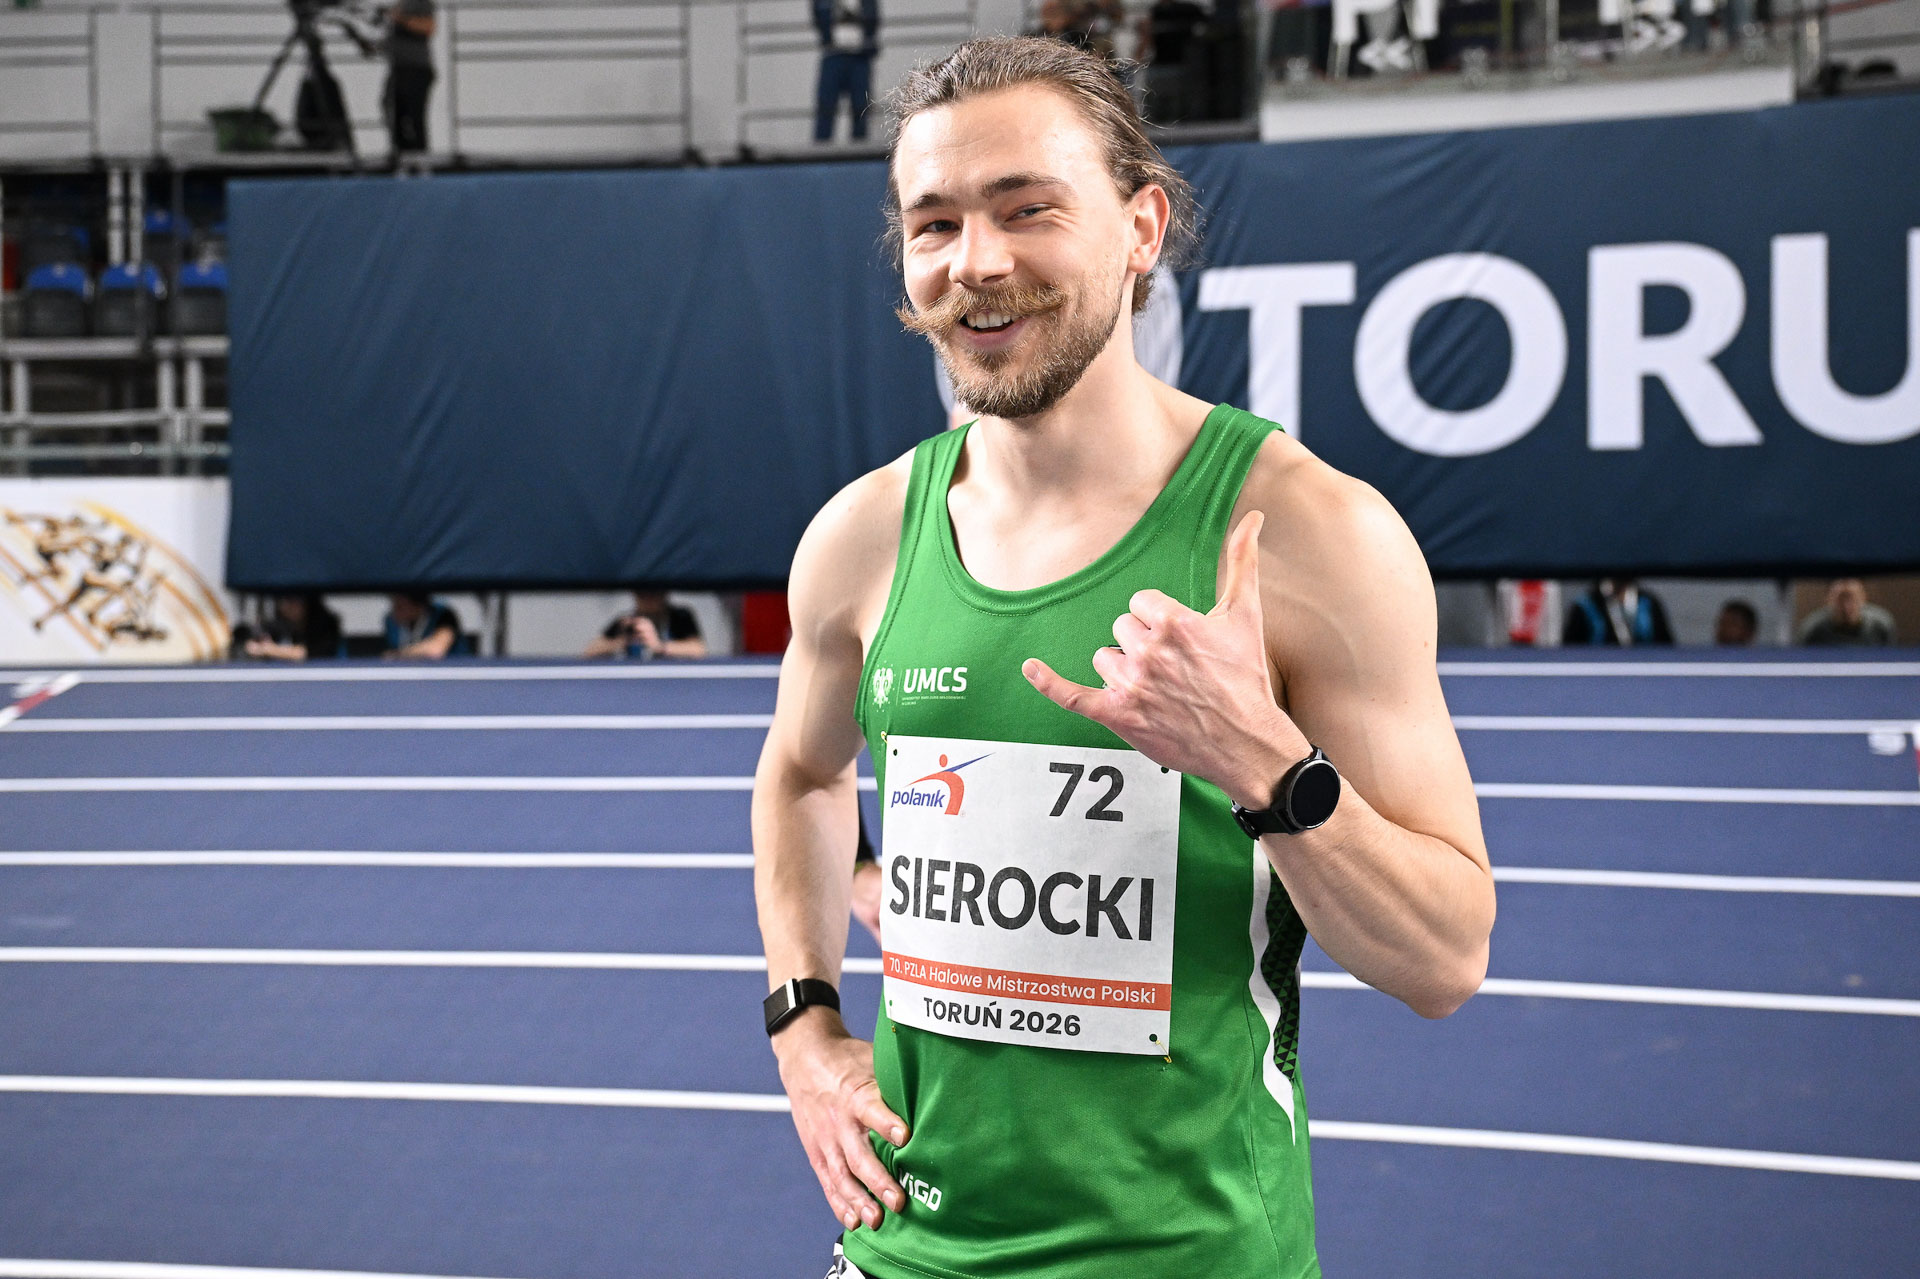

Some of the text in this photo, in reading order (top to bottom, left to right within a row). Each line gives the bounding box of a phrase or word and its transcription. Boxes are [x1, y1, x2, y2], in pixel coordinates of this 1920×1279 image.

[1199, 228, 1920, 458] TORU
[903, 667, 968, 693] UMCS
[1049, 762, 1125, 822] 72
[889, 855, 1155, 942] SIEROCKI
[889, 957, 1156, 1004] 70. PZLA Halowe Mistrzostwa Polski
[923, 996, 1081, 1037] TORUŃ 2026
